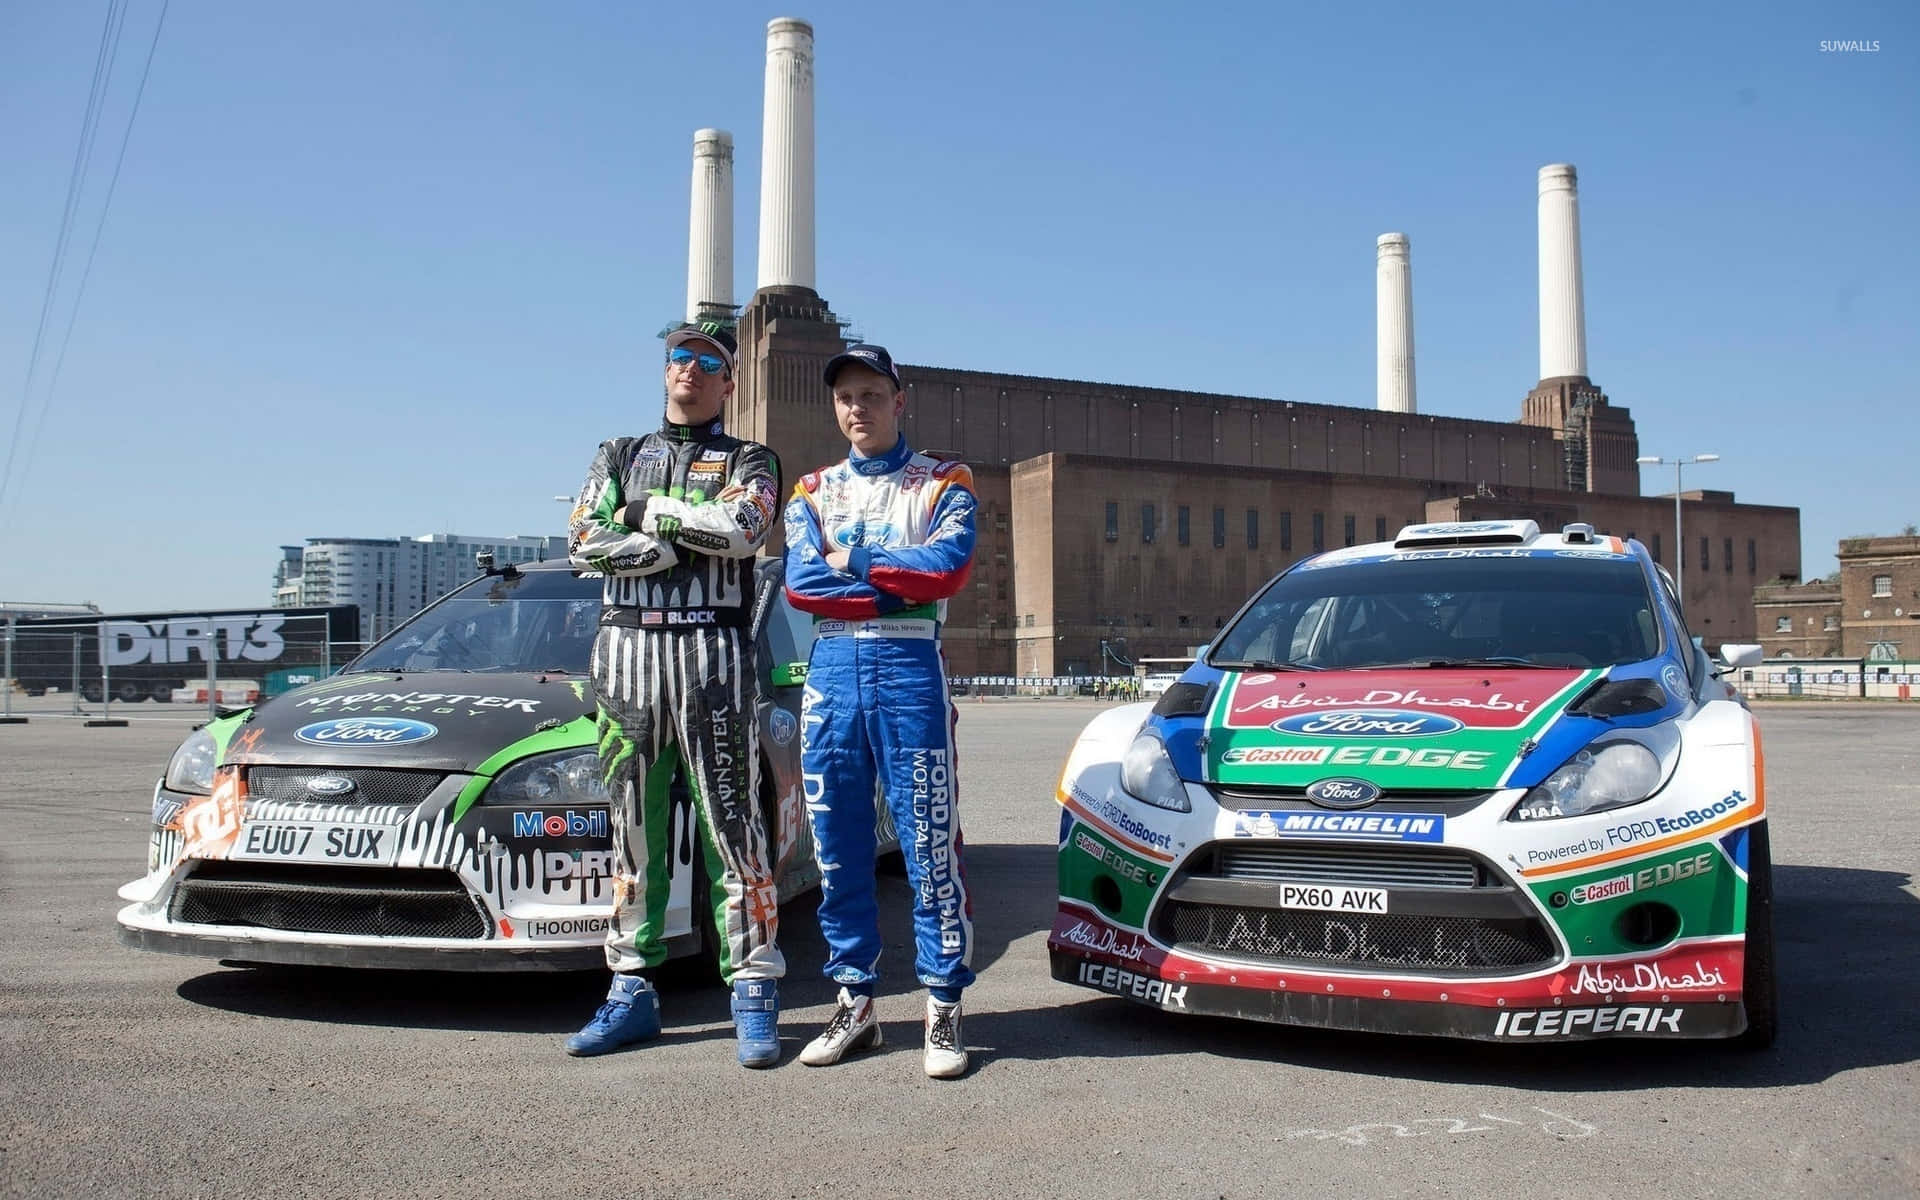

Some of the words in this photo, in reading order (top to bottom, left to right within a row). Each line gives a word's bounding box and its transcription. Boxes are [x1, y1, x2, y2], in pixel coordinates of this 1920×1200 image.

[668, 611, 716, 623] BLOCK
[311, 705, 487, 716] ENERGY
[1302, 711, 1427, 734] Ford
[315, 719, 412, 741] Ford
[1245, 749, 1324, 762] Castrol
[1332, 747, 1497, 770] EDGE
[913, 750, 928, 817] WORLD
[930, 748, 949, 825] FORD
[1321, 782, 1362, 801] Ford
[513, 810, 607, 838] Mobil
[1101, 801, 1121, 824] FORD
[1120, 813, 1172, 850] EcoBoost
[1284, 815, 1435, 834] MICHELIN
[1518, 805, 1564, 820] PIAA
[1528, 843, 1588, 863] Powered
[1590, 837, 1605, 852] by
[1606, 820, 1657, 846] FORD
[1656, 789, 1747, 834] EcoBoost
[245, 825, 314, 855] EU07
[325, 827, 384, 859] SUX
[914, 818, 930, 872] RALLY
[931, 829, 949, 882] ABU
[1103, 848, 1147, 883] EDGE
[1587, 876, 1631, 901] Castrol
[1637, 851, 1713, 891] EDGE
[1284, 887, 1332, 907] PX60
[1341, 889, 1383, 910] AVK
[937, 881, 961, 954] DHABI
[1079, 962, 1188, 1008] ICEPEAK
[1494, 1007, 1684, 1037] ICEPEAK
